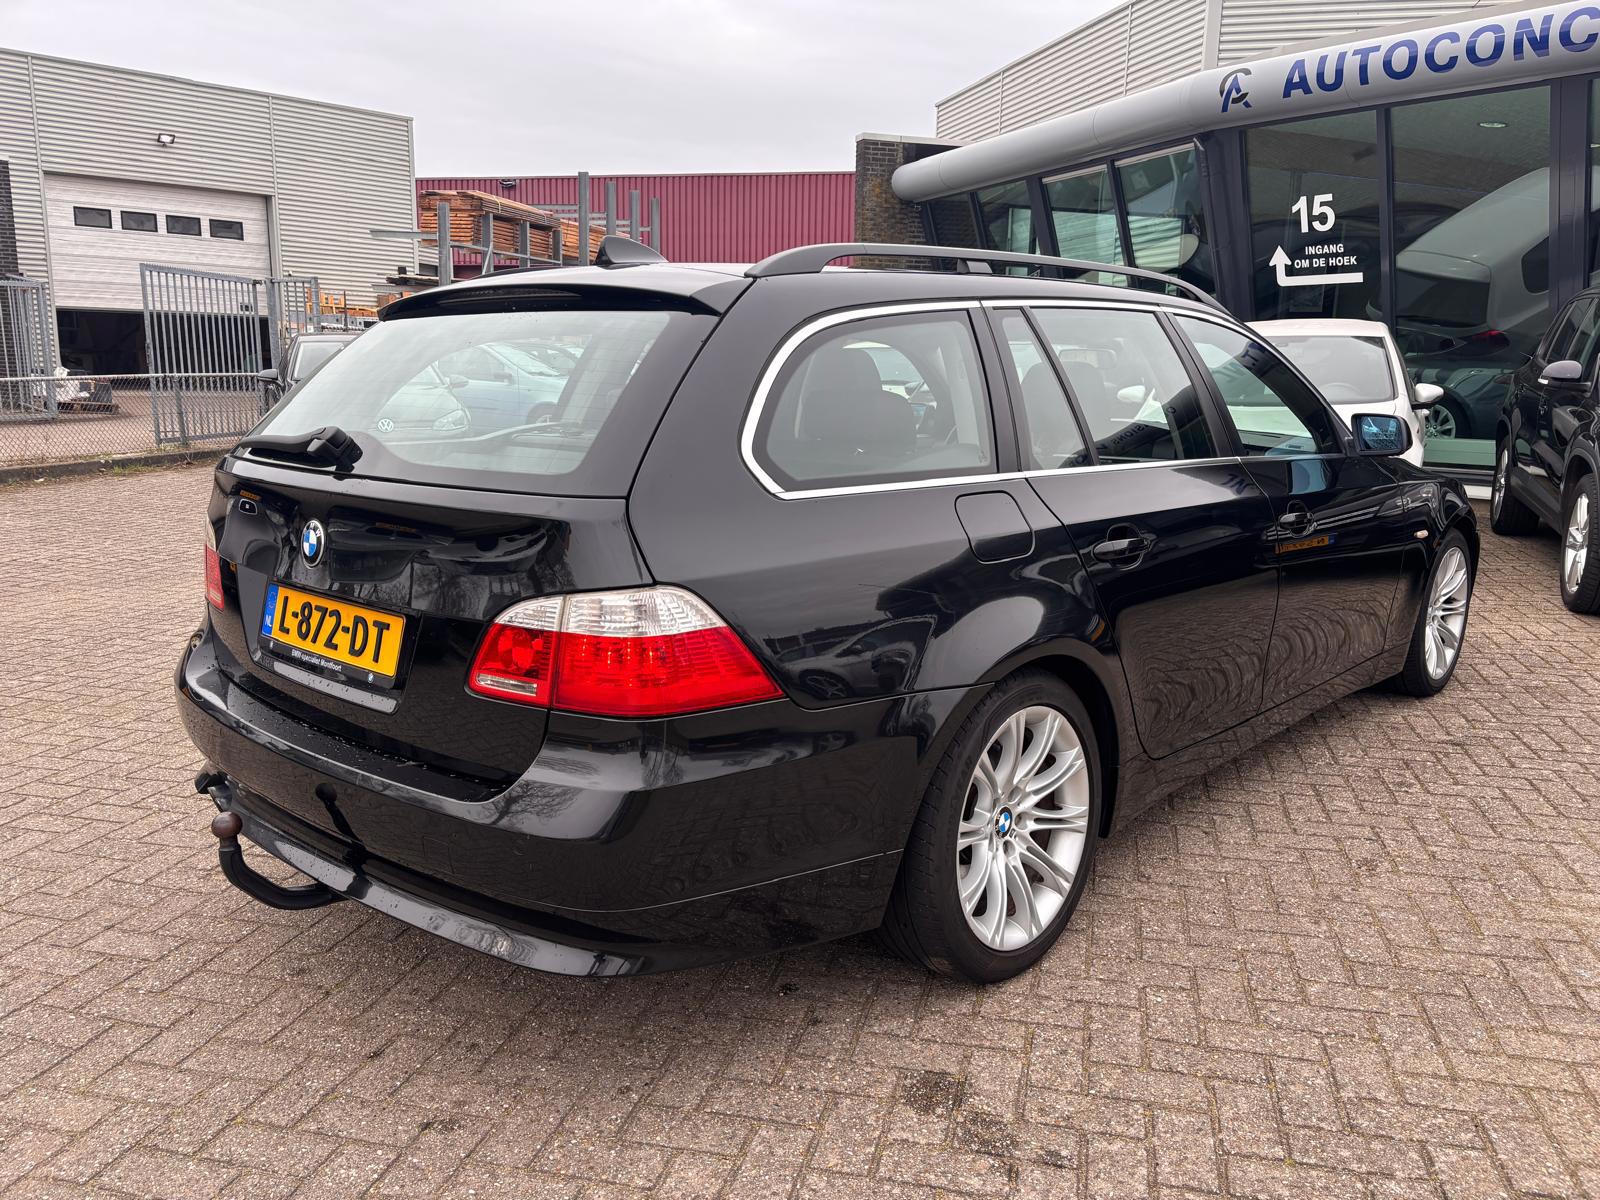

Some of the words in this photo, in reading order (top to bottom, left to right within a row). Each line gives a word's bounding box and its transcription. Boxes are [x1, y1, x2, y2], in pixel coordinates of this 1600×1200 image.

[1282, 7, 1600, 99] AUTOCONC
[1291, 193, 1336, 234] 15
[1294, 259, 1310, 269] OM
[1312, 258, 1326, 267] DE
[1329, 255, 1358, 266] HOEK
[1305, 244, 1345, 255] INGANG
[278, 595, 391, 664] L-872-DT
